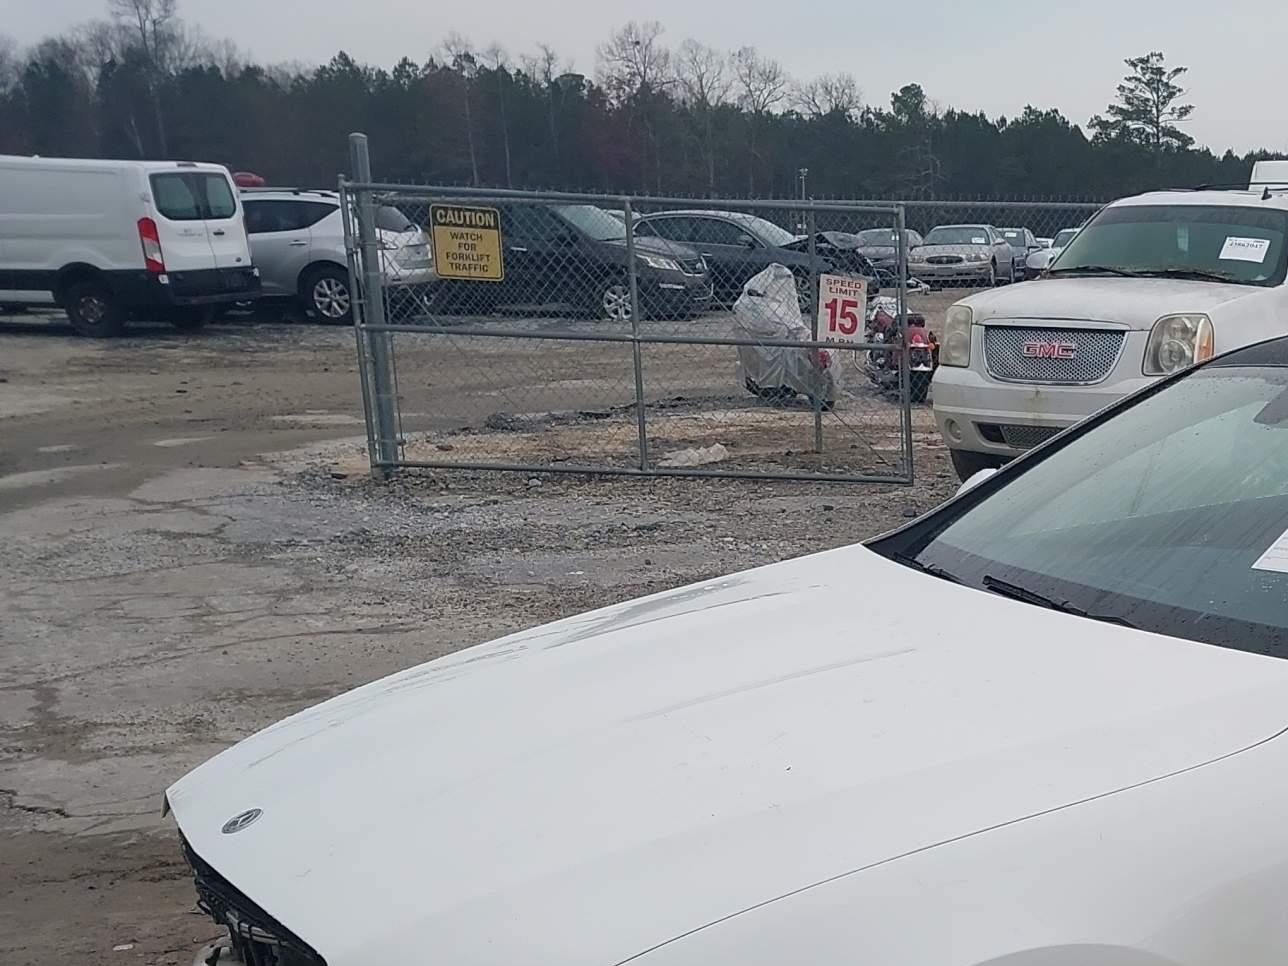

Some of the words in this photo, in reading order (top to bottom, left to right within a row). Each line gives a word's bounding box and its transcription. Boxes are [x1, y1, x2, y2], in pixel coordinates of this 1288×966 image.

[436, 209, 495, 227] CAUTION
[450, 232, 483, 241] WATCH
[458, 242, 477, 251] FOR
[446, 252, 490, 262] FORKLIFT
[449, 262, 489, 273] TRAFFIC
[826, 278, 861, 289] SPEED
[829, 287, 859, 296] LIMIT
[825, 298, 858, 335] 15
[1023, 342, 1075, 359] GMC
